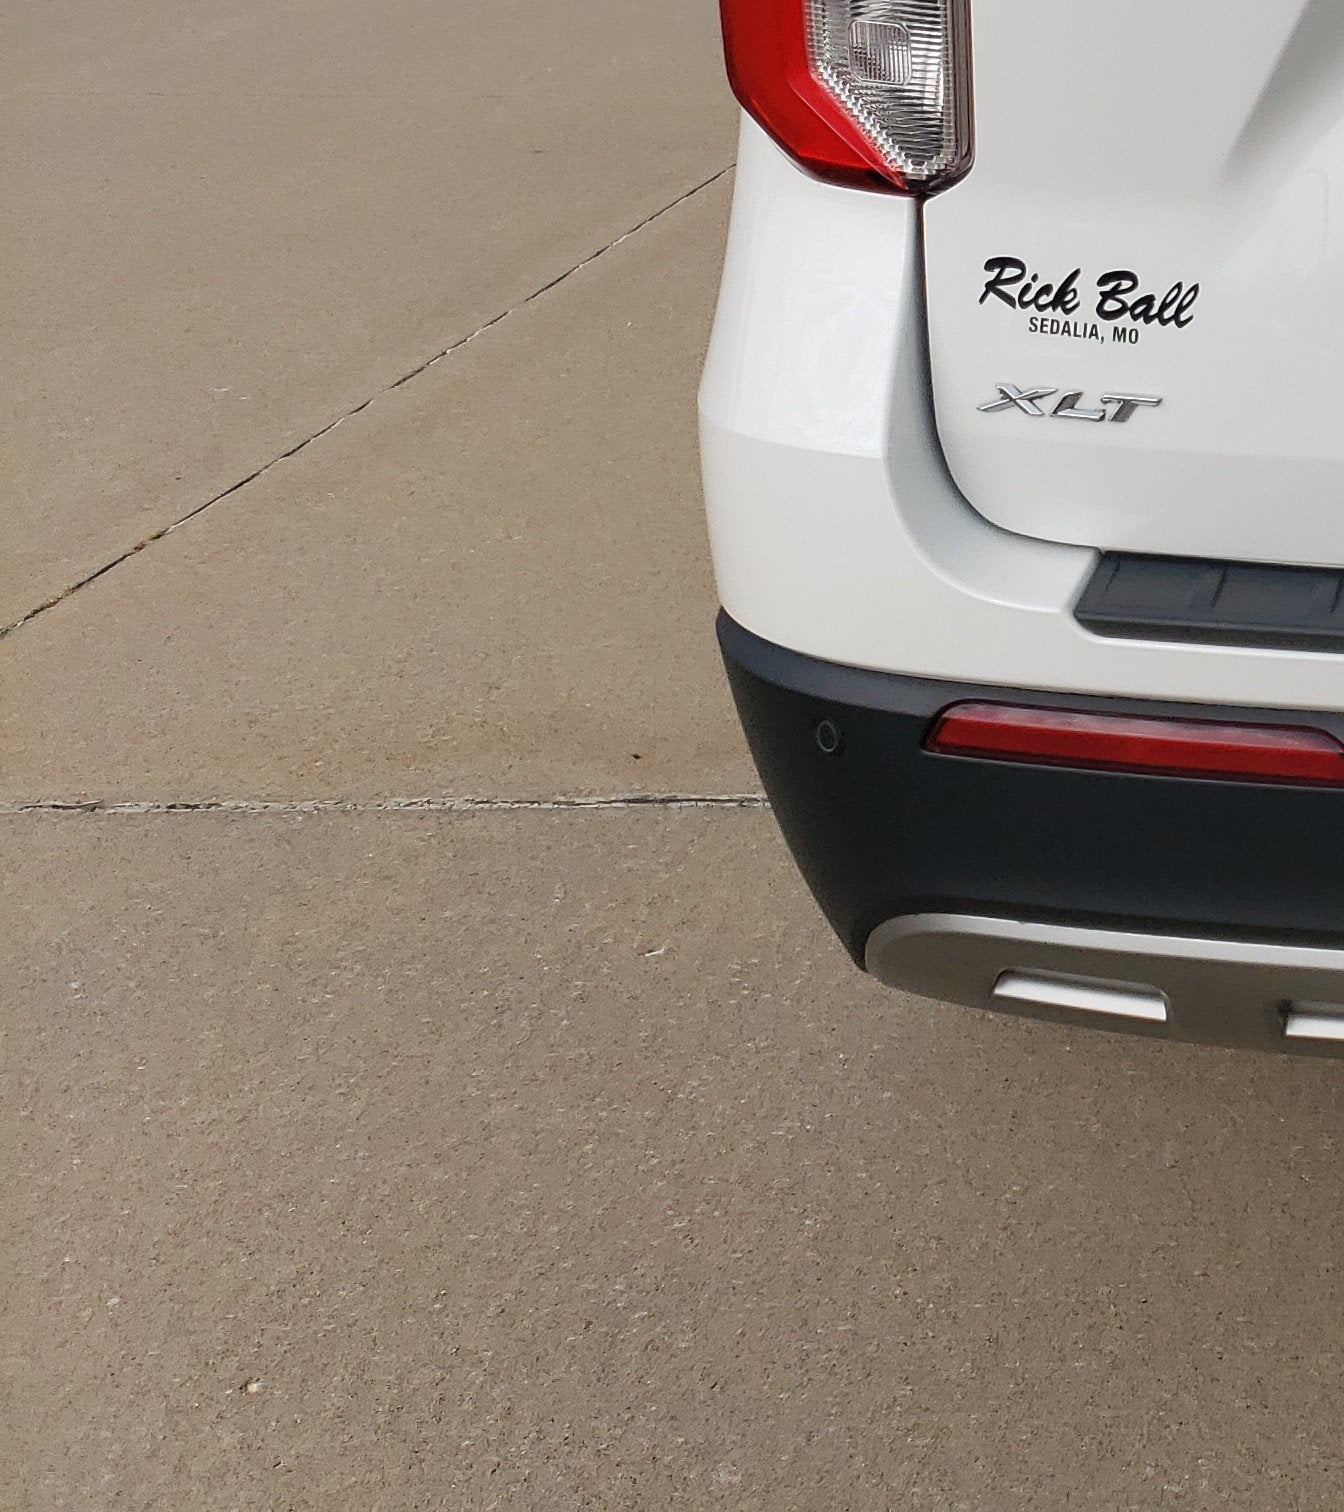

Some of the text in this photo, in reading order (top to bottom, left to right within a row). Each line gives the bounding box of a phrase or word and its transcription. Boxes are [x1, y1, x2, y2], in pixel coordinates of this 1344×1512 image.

[977, 255, 1201, 329] Rick Ball
[1028, 316, 1140, 345] SEDALIA, MO
[975, 382, 1164, 423] XLT
